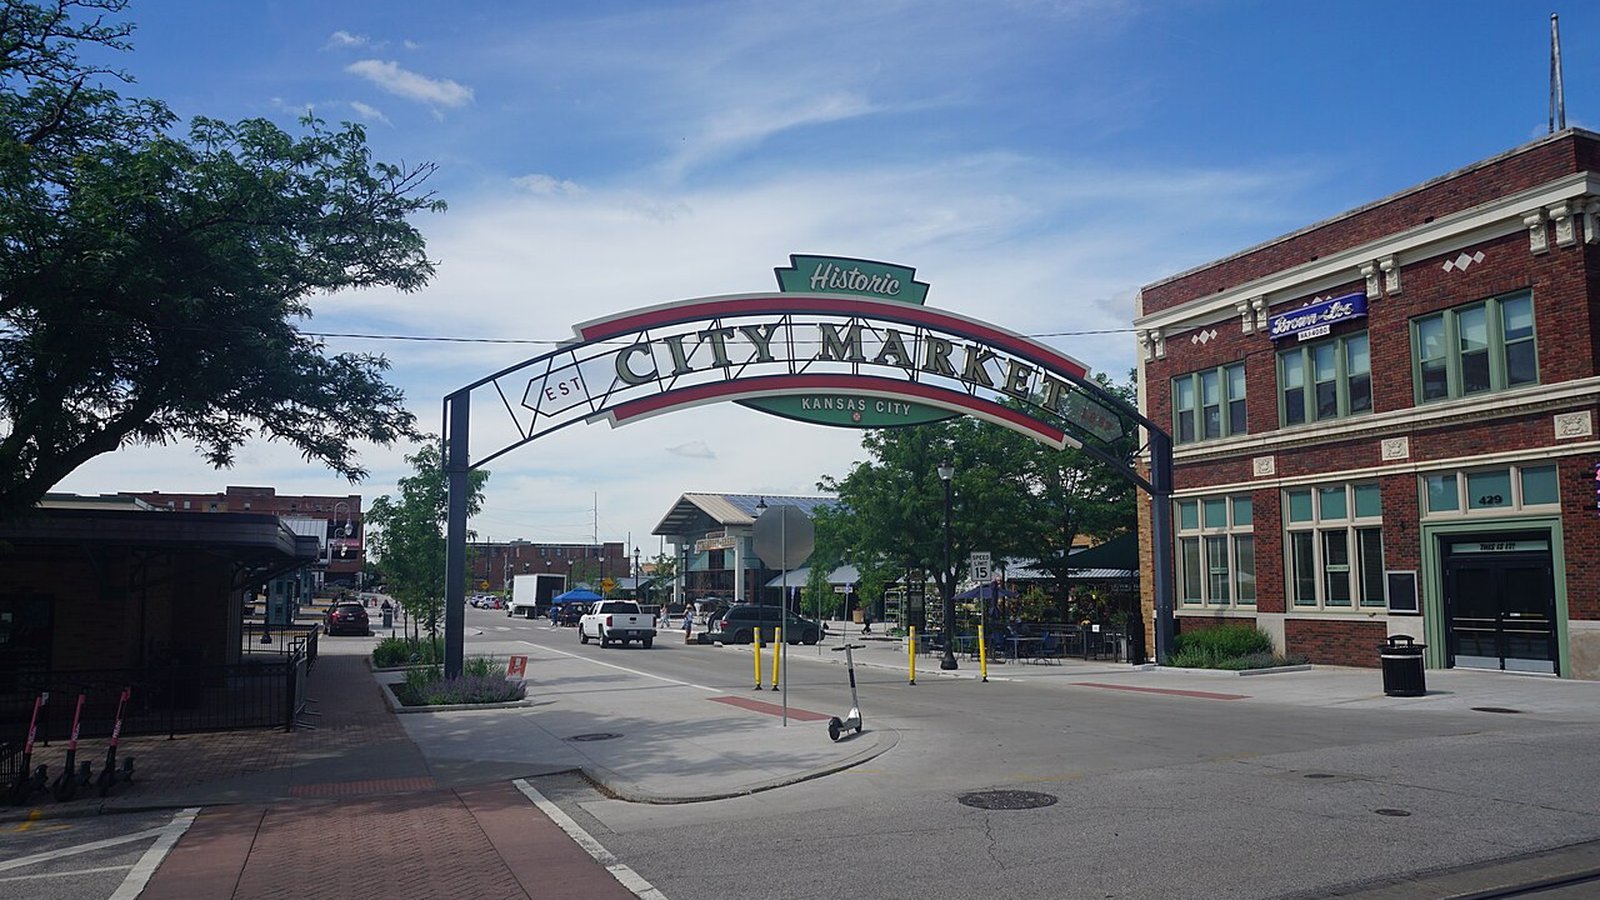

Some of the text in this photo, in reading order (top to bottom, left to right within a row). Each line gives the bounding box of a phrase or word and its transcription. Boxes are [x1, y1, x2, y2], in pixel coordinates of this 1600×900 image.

[810, 262, 900, 295] Historic
[1272, 314, 1318, 334] Brown
[615, 322, 1072, 414] CITY MARKET
[545, 377, 580, 401] EST
[802, 398, 911, 415] KANSAS CITY
[1478, 494, 1503, 505] 429
[1480, 543, 1495, 551] THIS
[975, 566, 988, 578] 15
